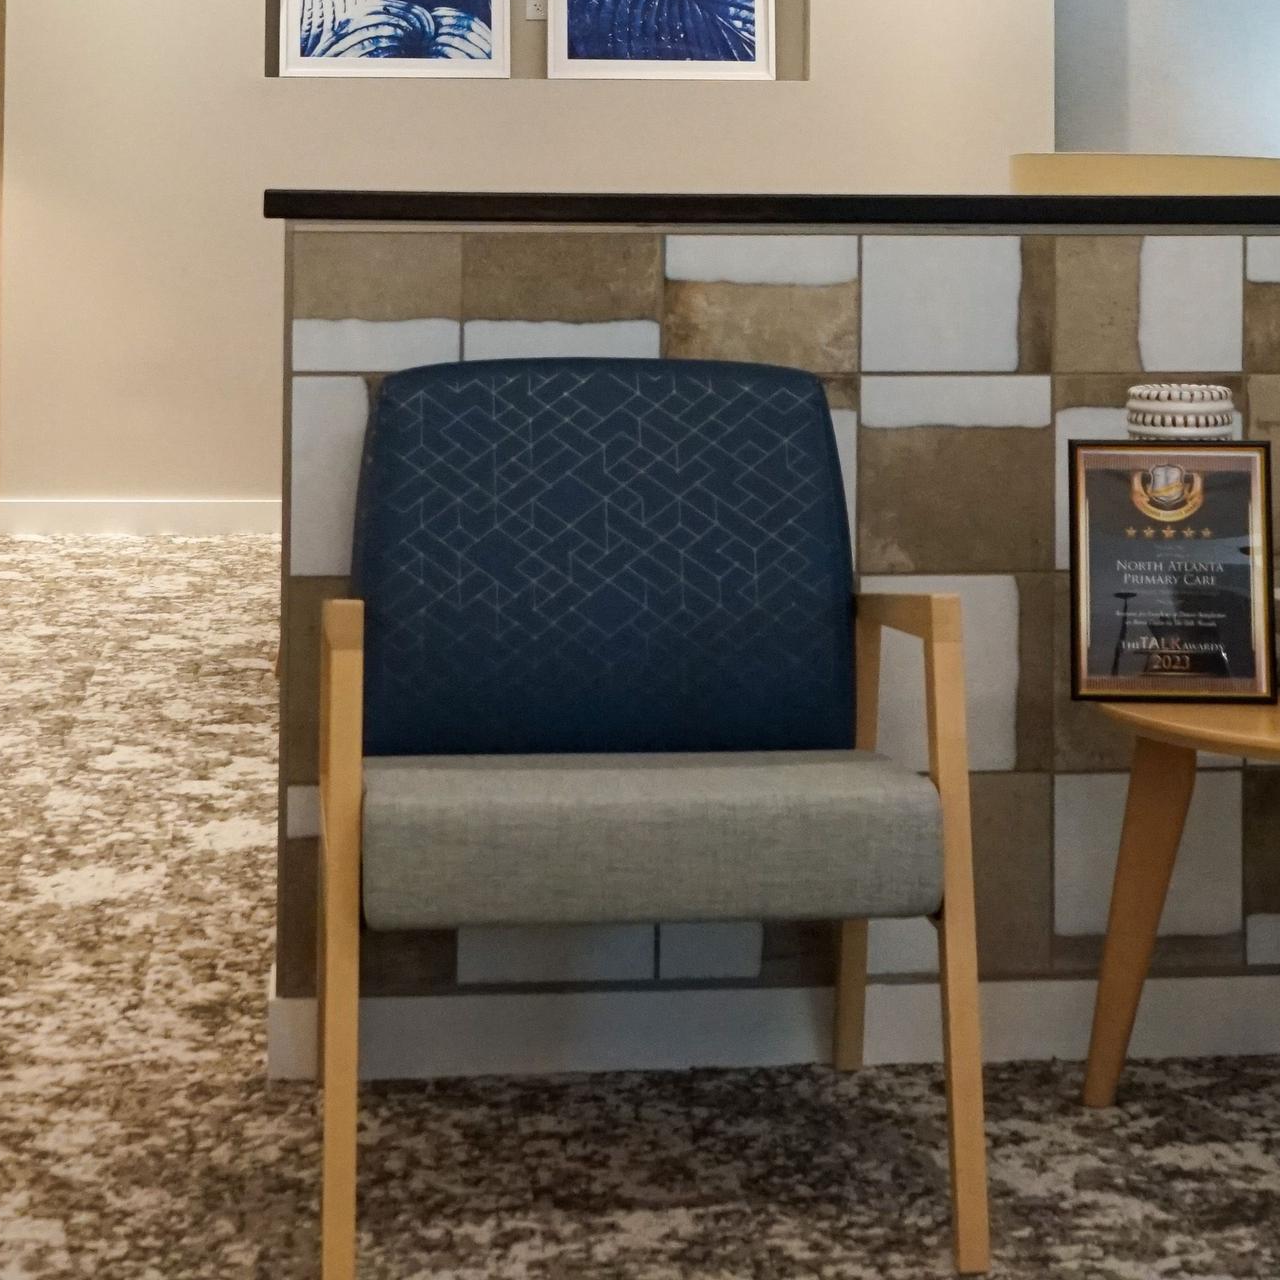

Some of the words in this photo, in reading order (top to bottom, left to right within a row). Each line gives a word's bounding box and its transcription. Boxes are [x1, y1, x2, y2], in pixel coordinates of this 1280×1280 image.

[1116, 560, 1163, 571] NORTH
[1168, 560, 1224, 572] ATLANTA
[1123, 573, 1178, 585] PRIMARY
[1183, 574, 1216, 586] CARE
[1140, 636, 1181, 650] TALK
[1152, 655, 1190, 669] 2023
